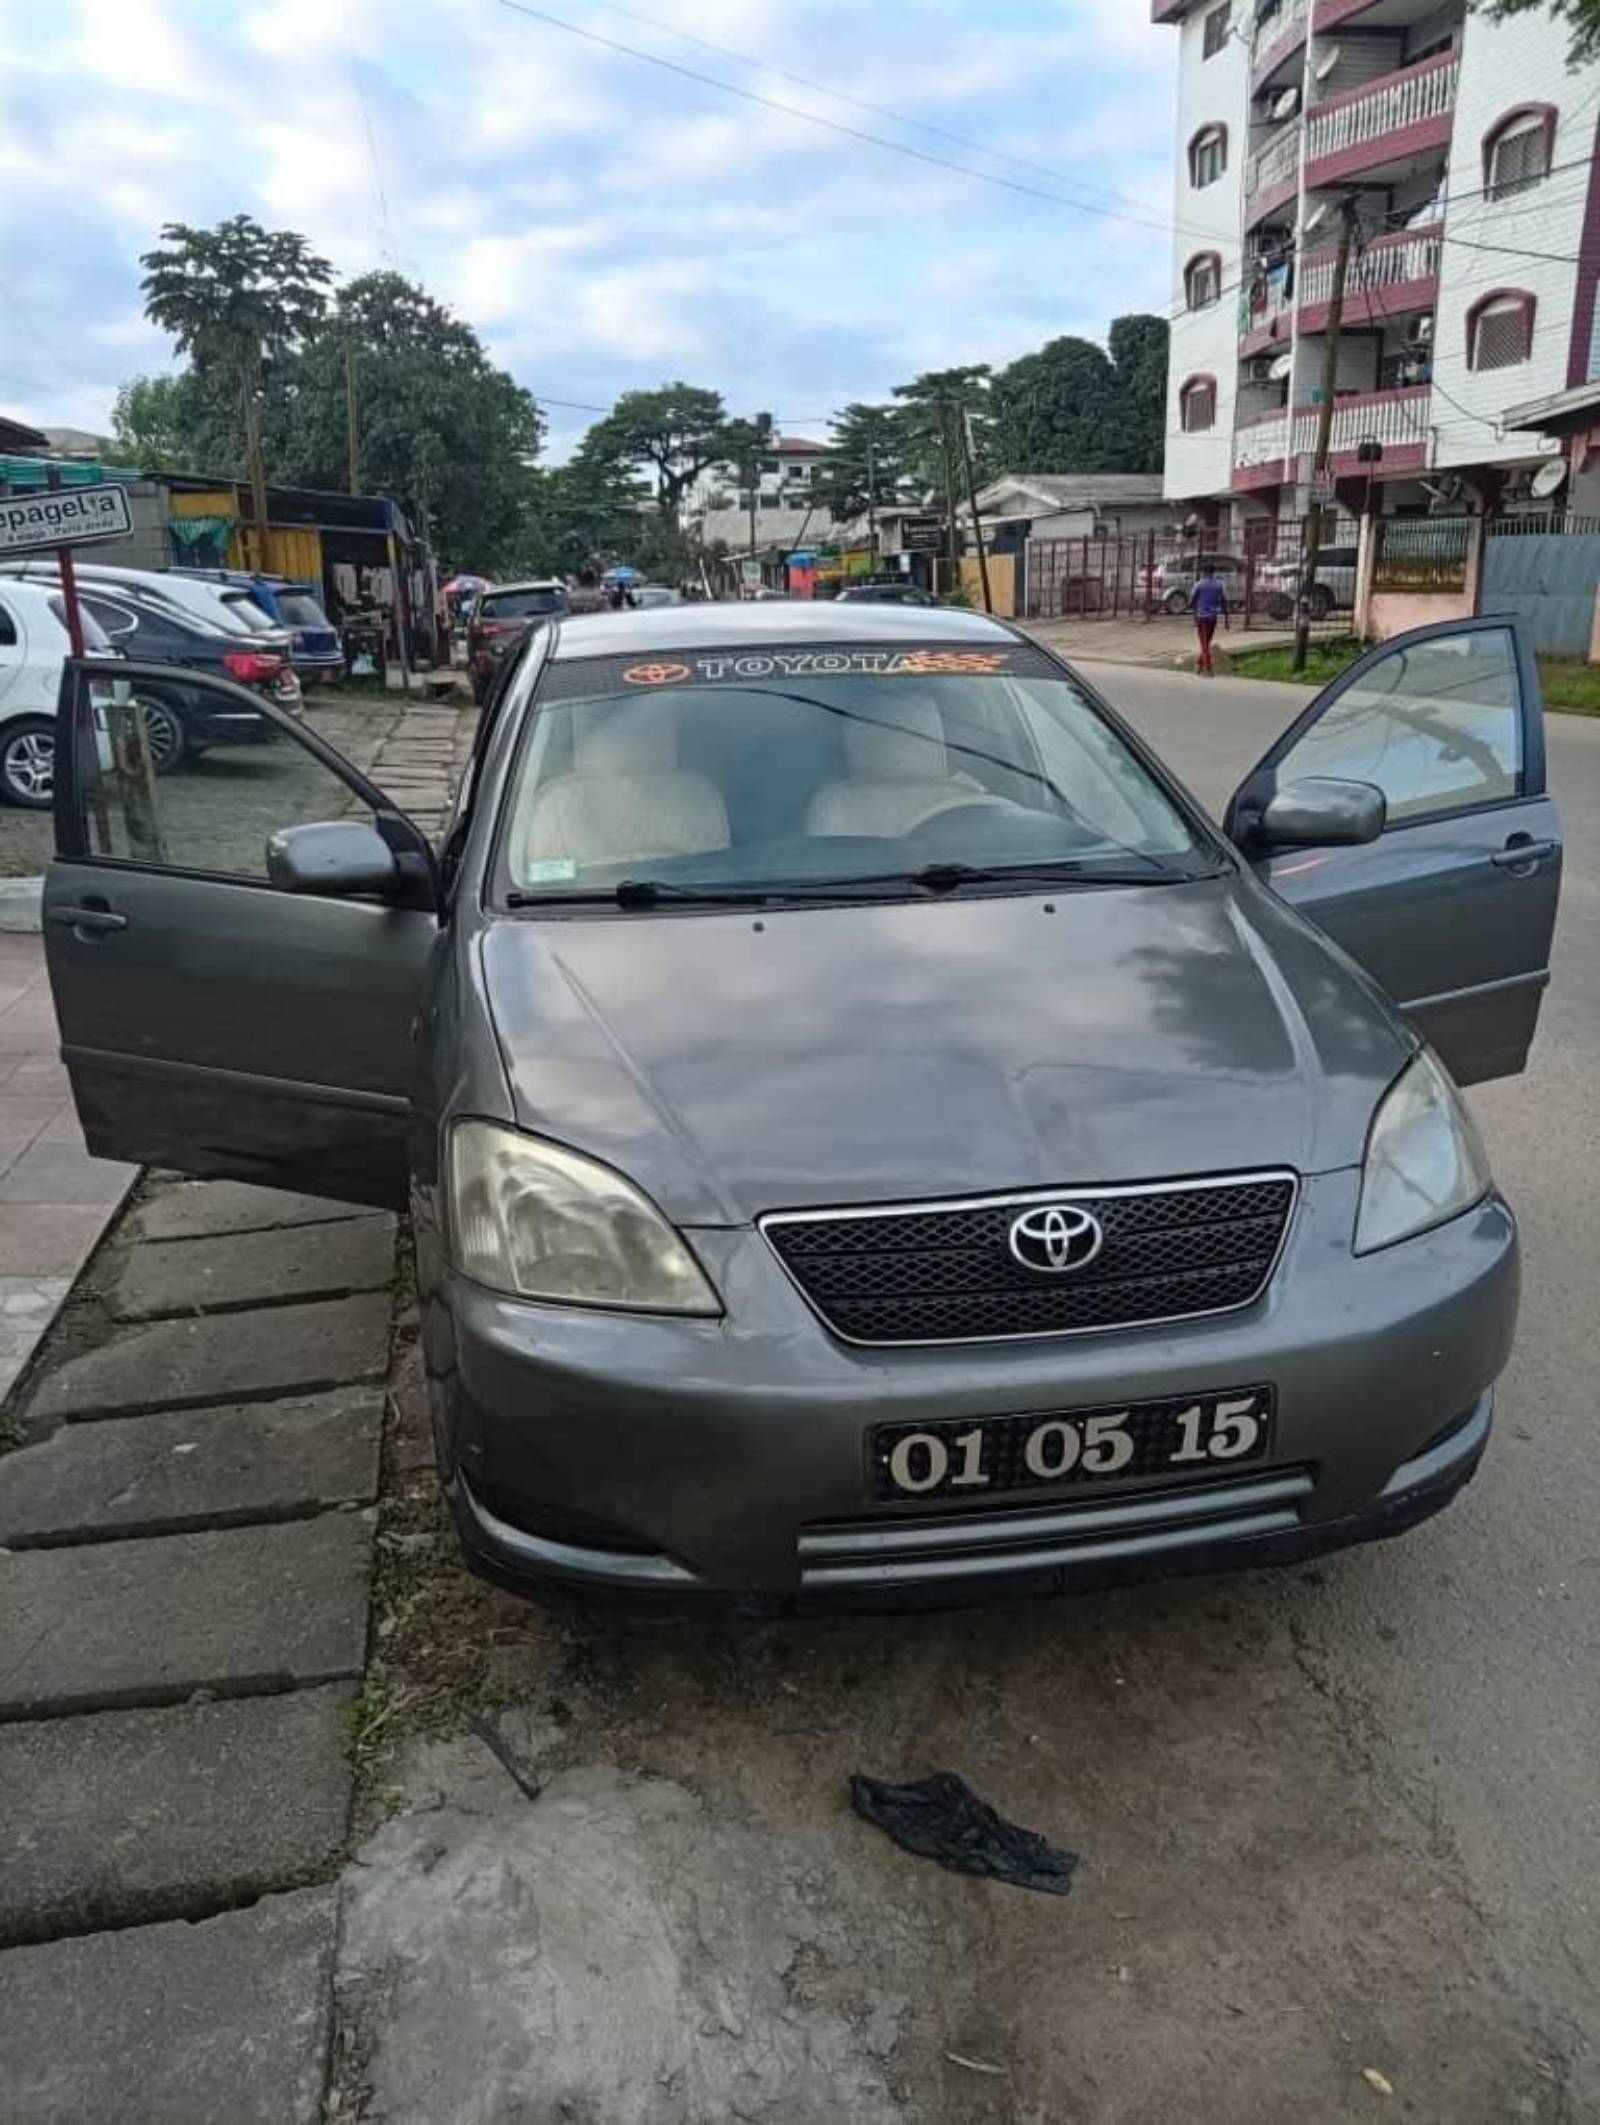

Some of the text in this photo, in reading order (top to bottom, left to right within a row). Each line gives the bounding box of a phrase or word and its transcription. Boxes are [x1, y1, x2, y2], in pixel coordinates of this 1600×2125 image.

[697, 653, 919, 679] TOYOTA
[890, 1398, 1259, 1492] 01 05 15
